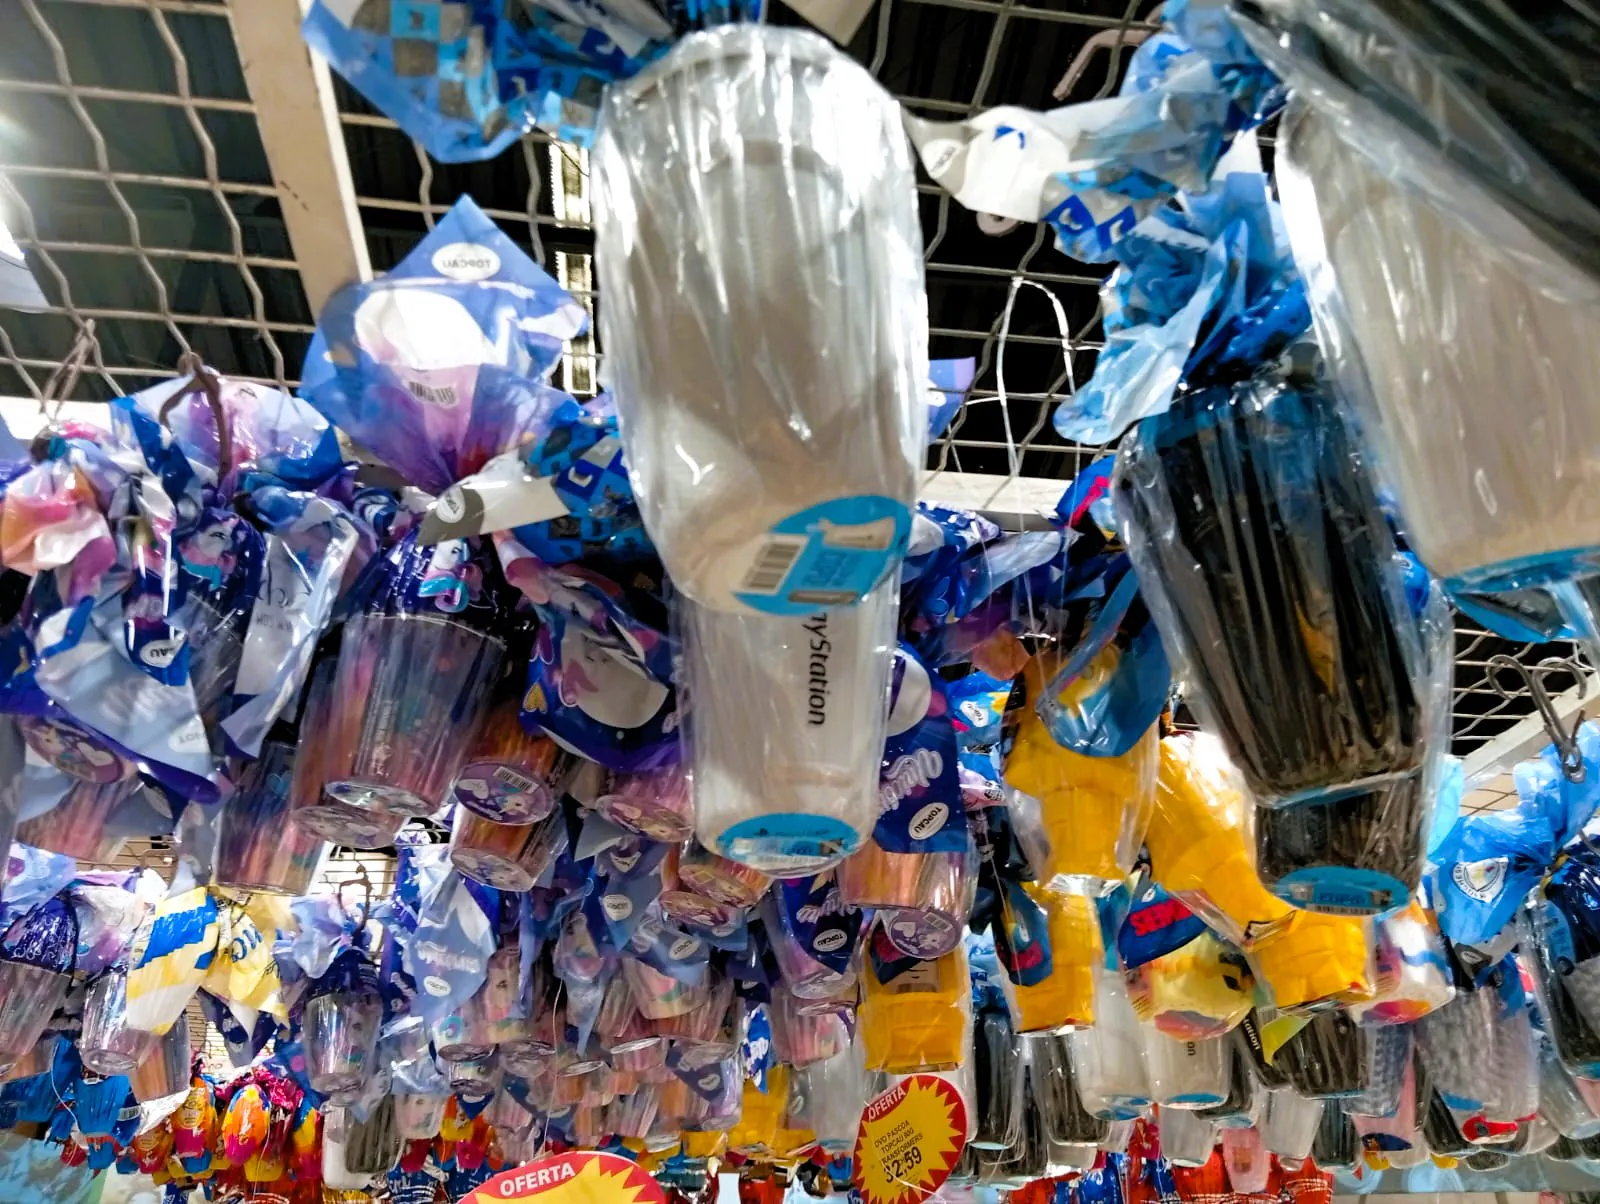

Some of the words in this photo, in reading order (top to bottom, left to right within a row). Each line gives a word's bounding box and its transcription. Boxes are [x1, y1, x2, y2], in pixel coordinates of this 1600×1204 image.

[914, 806, 942, 833] TOPCAU
[868, 1086, 906, 1120] OFERTA
[500, 1163, 576, 1196] OFERTA
[883, 1146, 922, 1183] 32,59
